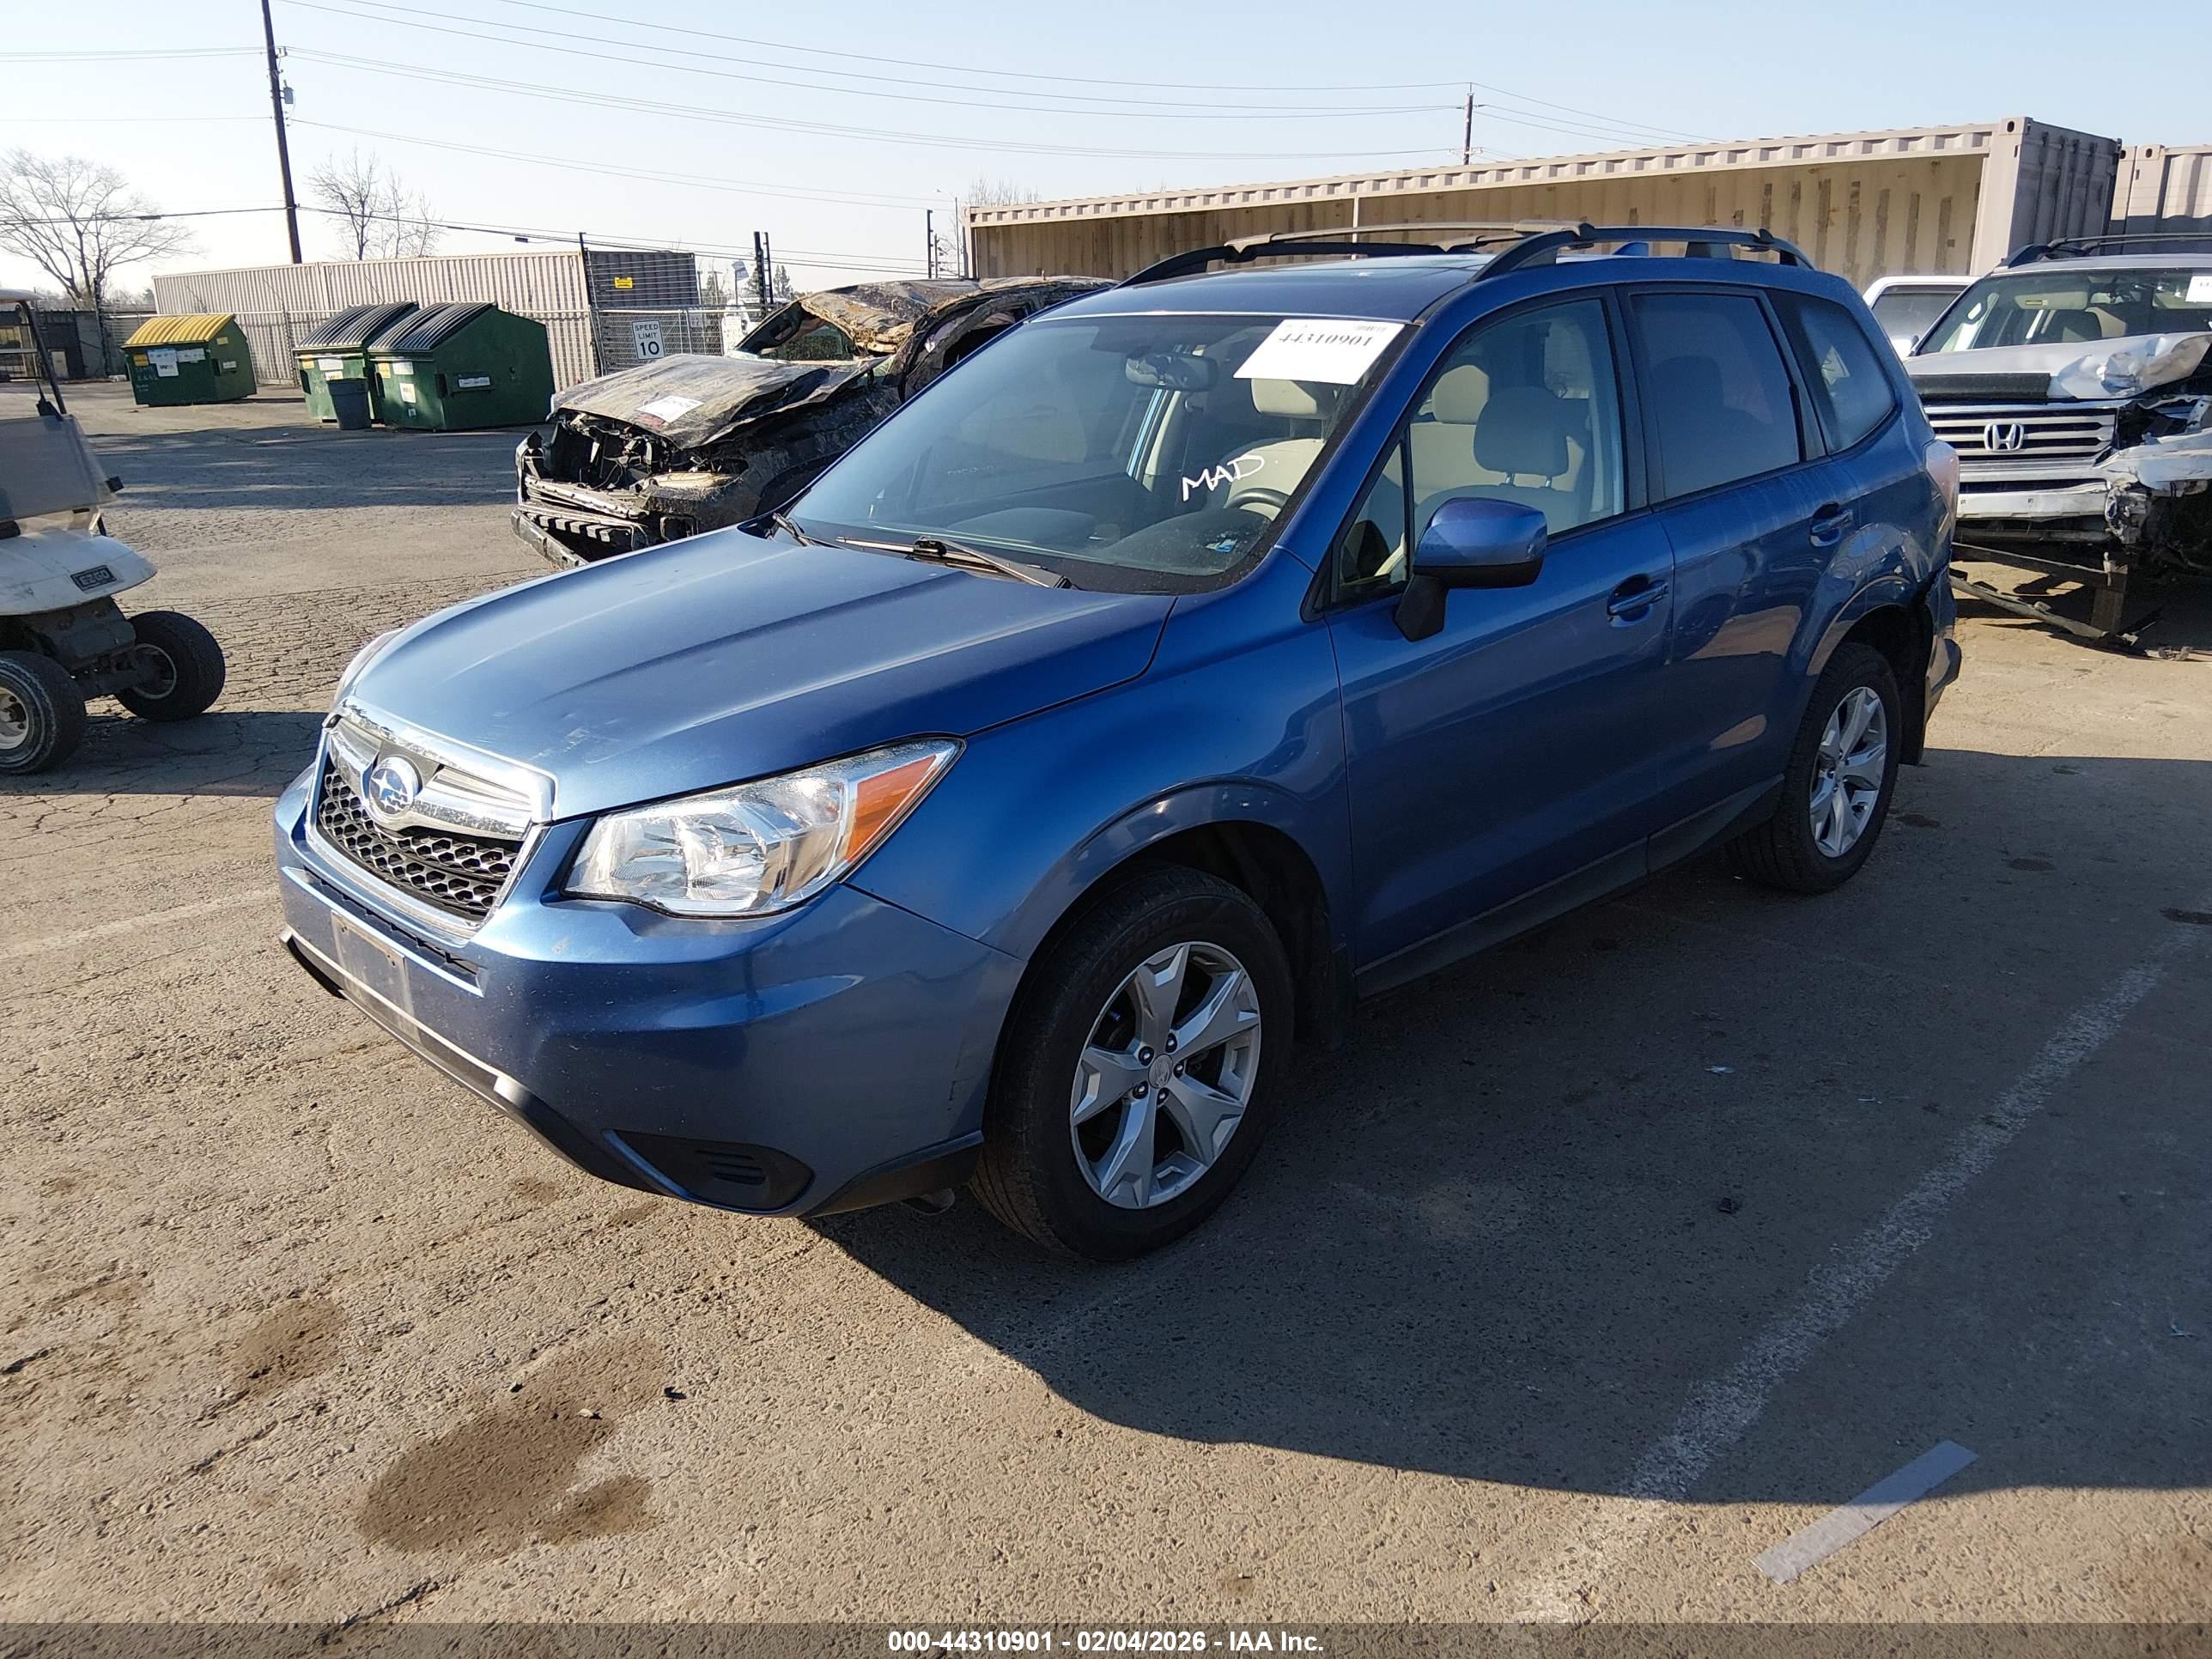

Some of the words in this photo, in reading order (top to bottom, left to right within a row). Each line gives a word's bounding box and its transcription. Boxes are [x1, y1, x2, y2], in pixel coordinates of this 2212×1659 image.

[1279, 333, 1373, 346] 44310901
[640, 341, 659, 356] 10
[1182, 454, 1265, 502] MAD
